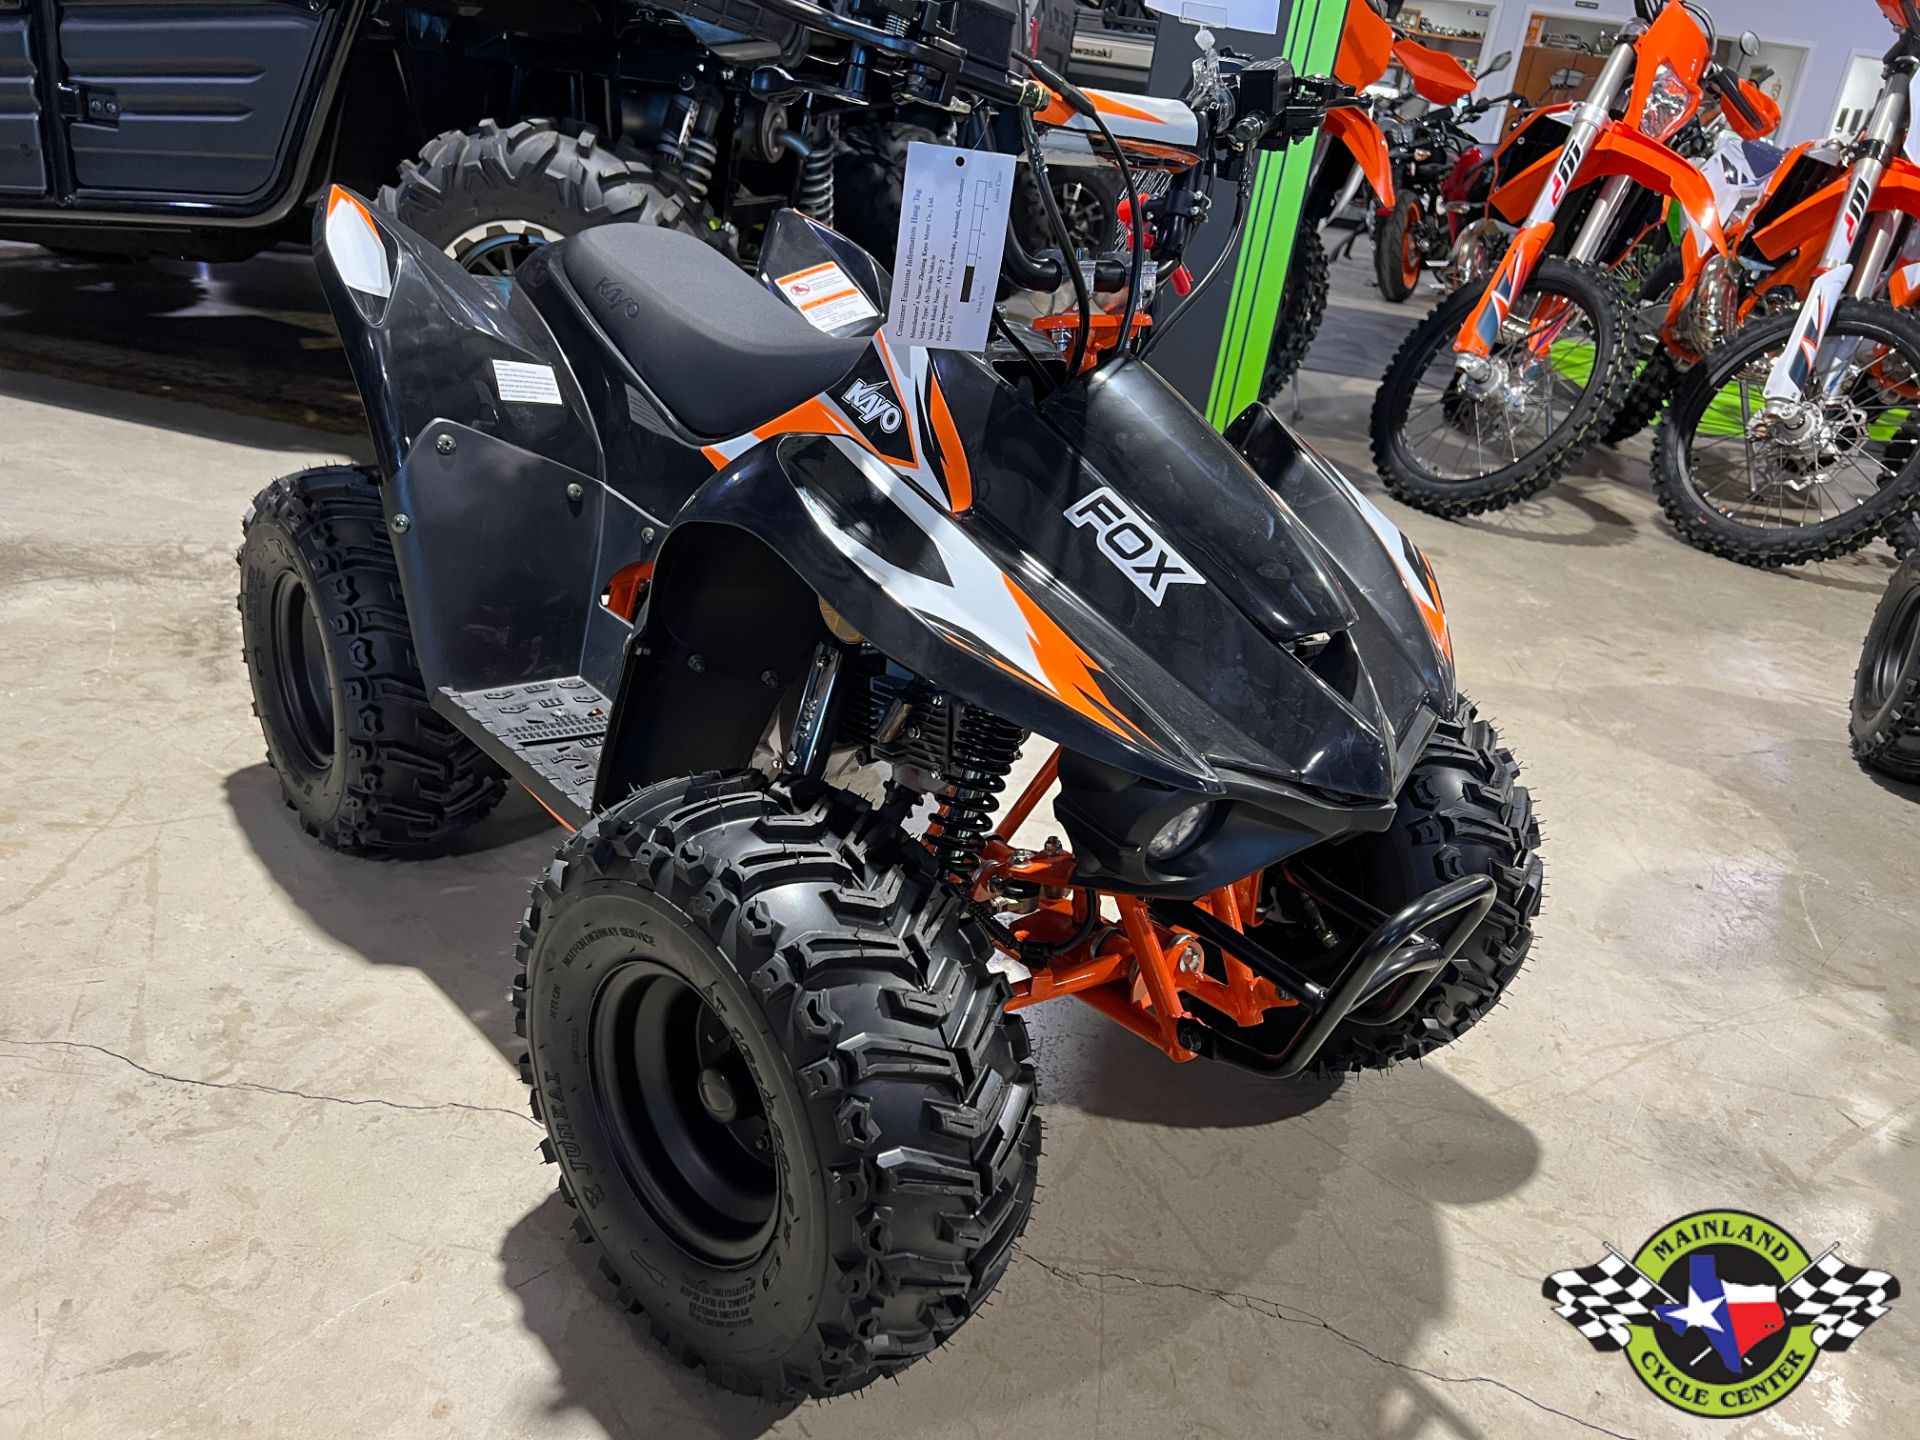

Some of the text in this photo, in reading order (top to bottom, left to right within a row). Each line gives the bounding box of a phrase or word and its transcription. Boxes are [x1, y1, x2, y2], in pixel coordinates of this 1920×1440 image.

[896, 188, 922, 336] Consumer Emissions Information Hang Tag
[593, 276, 640, 320] KAYO
[841, 378, 902, 434] KAYO
[1075, 494, 1186, 592] FOX
[619, 926, 657, 948] SERVICE
[549, 984, 561, 1019] NYLON
